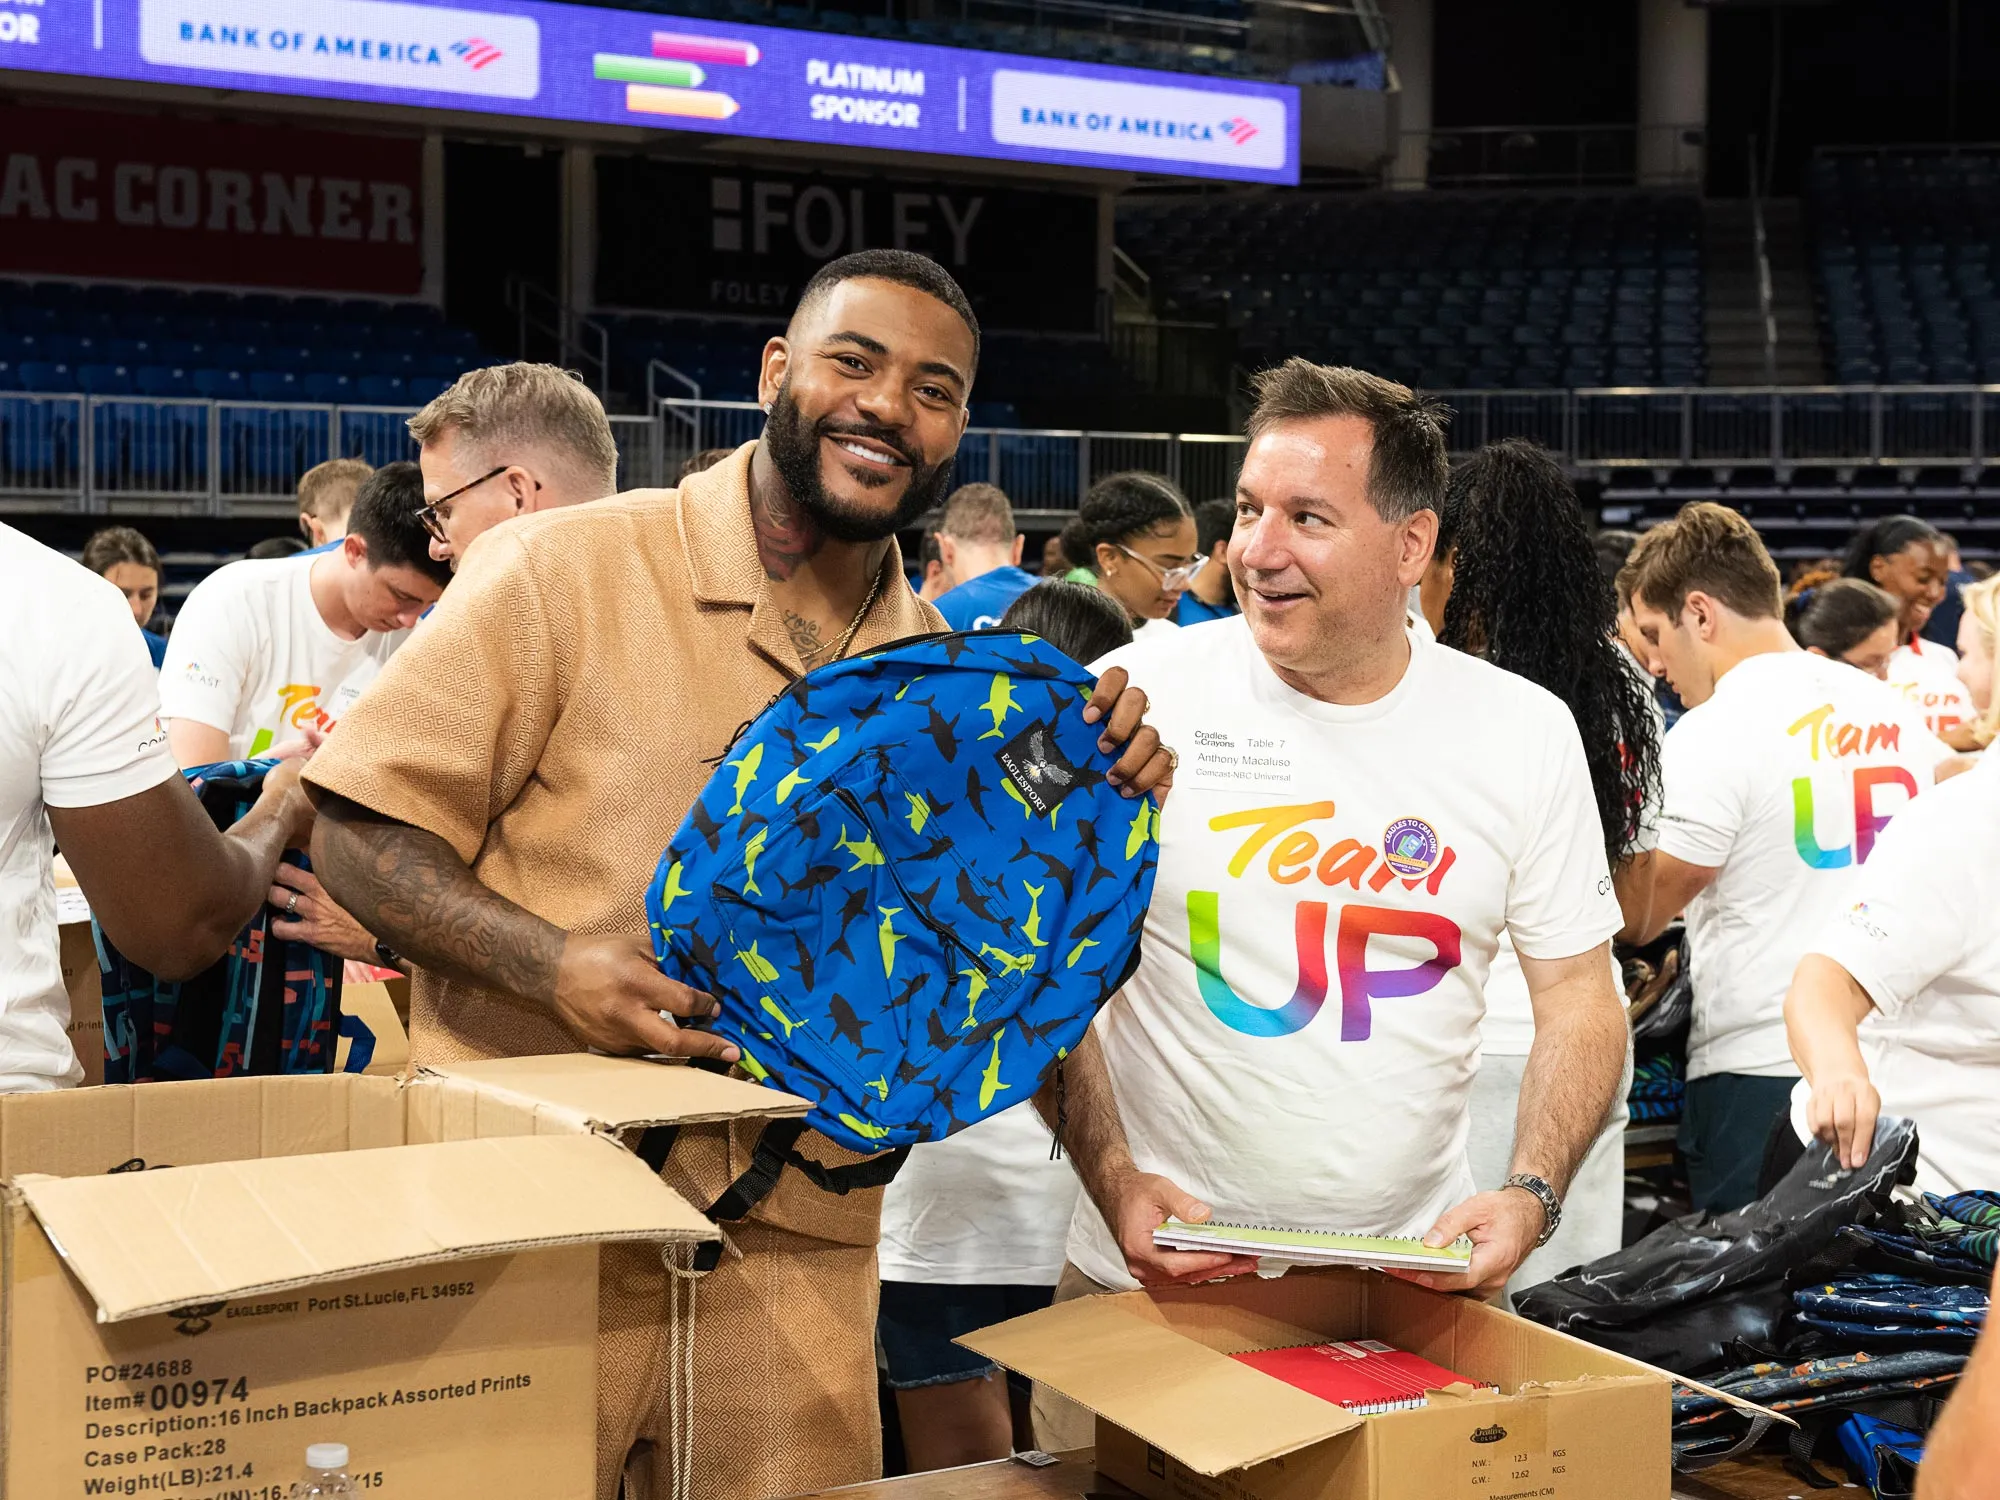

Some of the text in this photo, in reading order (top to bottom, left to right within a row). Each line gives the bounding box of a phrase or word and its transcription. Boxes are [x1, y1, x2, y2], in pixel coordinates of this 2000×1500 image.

[179, 20, 442, 66] BANK OF AMERICA
[806, 58, 925, 97] PLATINUM
[810, 94, 921, 129] SPONSOR
[1021, 106, 1214, 142] BANK OF AMERICA
[114, 161, 415, 245] CORNER
[752, 179, 986, 266] FOLEY
[712, 279, 790, 306] FOLEY
[1194, 730, 1228, 740] Cradles
[1247, 738, 1286, 748] Table 7
[1786, 703, 1901, 762] Team
[1195, 768, 1291, 782] Comcast-NBC Universal
[1197, 752, 1291, 767] Anthony Macaluso
[1001, 752, 1047, 812] EAGLESPORT
[1385, 819, 1437, 854] CRADLES TO CRAYONS
[1186, 889, 1462, 1042] UP
[226, 1301, 299, 1319] EAGLESPORT
[307, 1297, 341, 1312] Port
[432, 1281, 475, 1299] 34952
[86, 1359, 192, 1383] PO#24688
[86, 1373, 532, 1439] Description:16 Inch Backpack Assorted Prints
[84, 1438, 227, 1468] Case Pack:28
[1513, 1454, 1528, 1463] 12.3
[1552, 1449, 1567, 1458] KGS
[84, 1462, 254, 1496] Weight(LB):21.4
[1511, 1470, 1530, 1479] 12.62
[1552, 1465, 1566, 1474] KGS
[1539, 1487, 1555, 1496] (CM)
